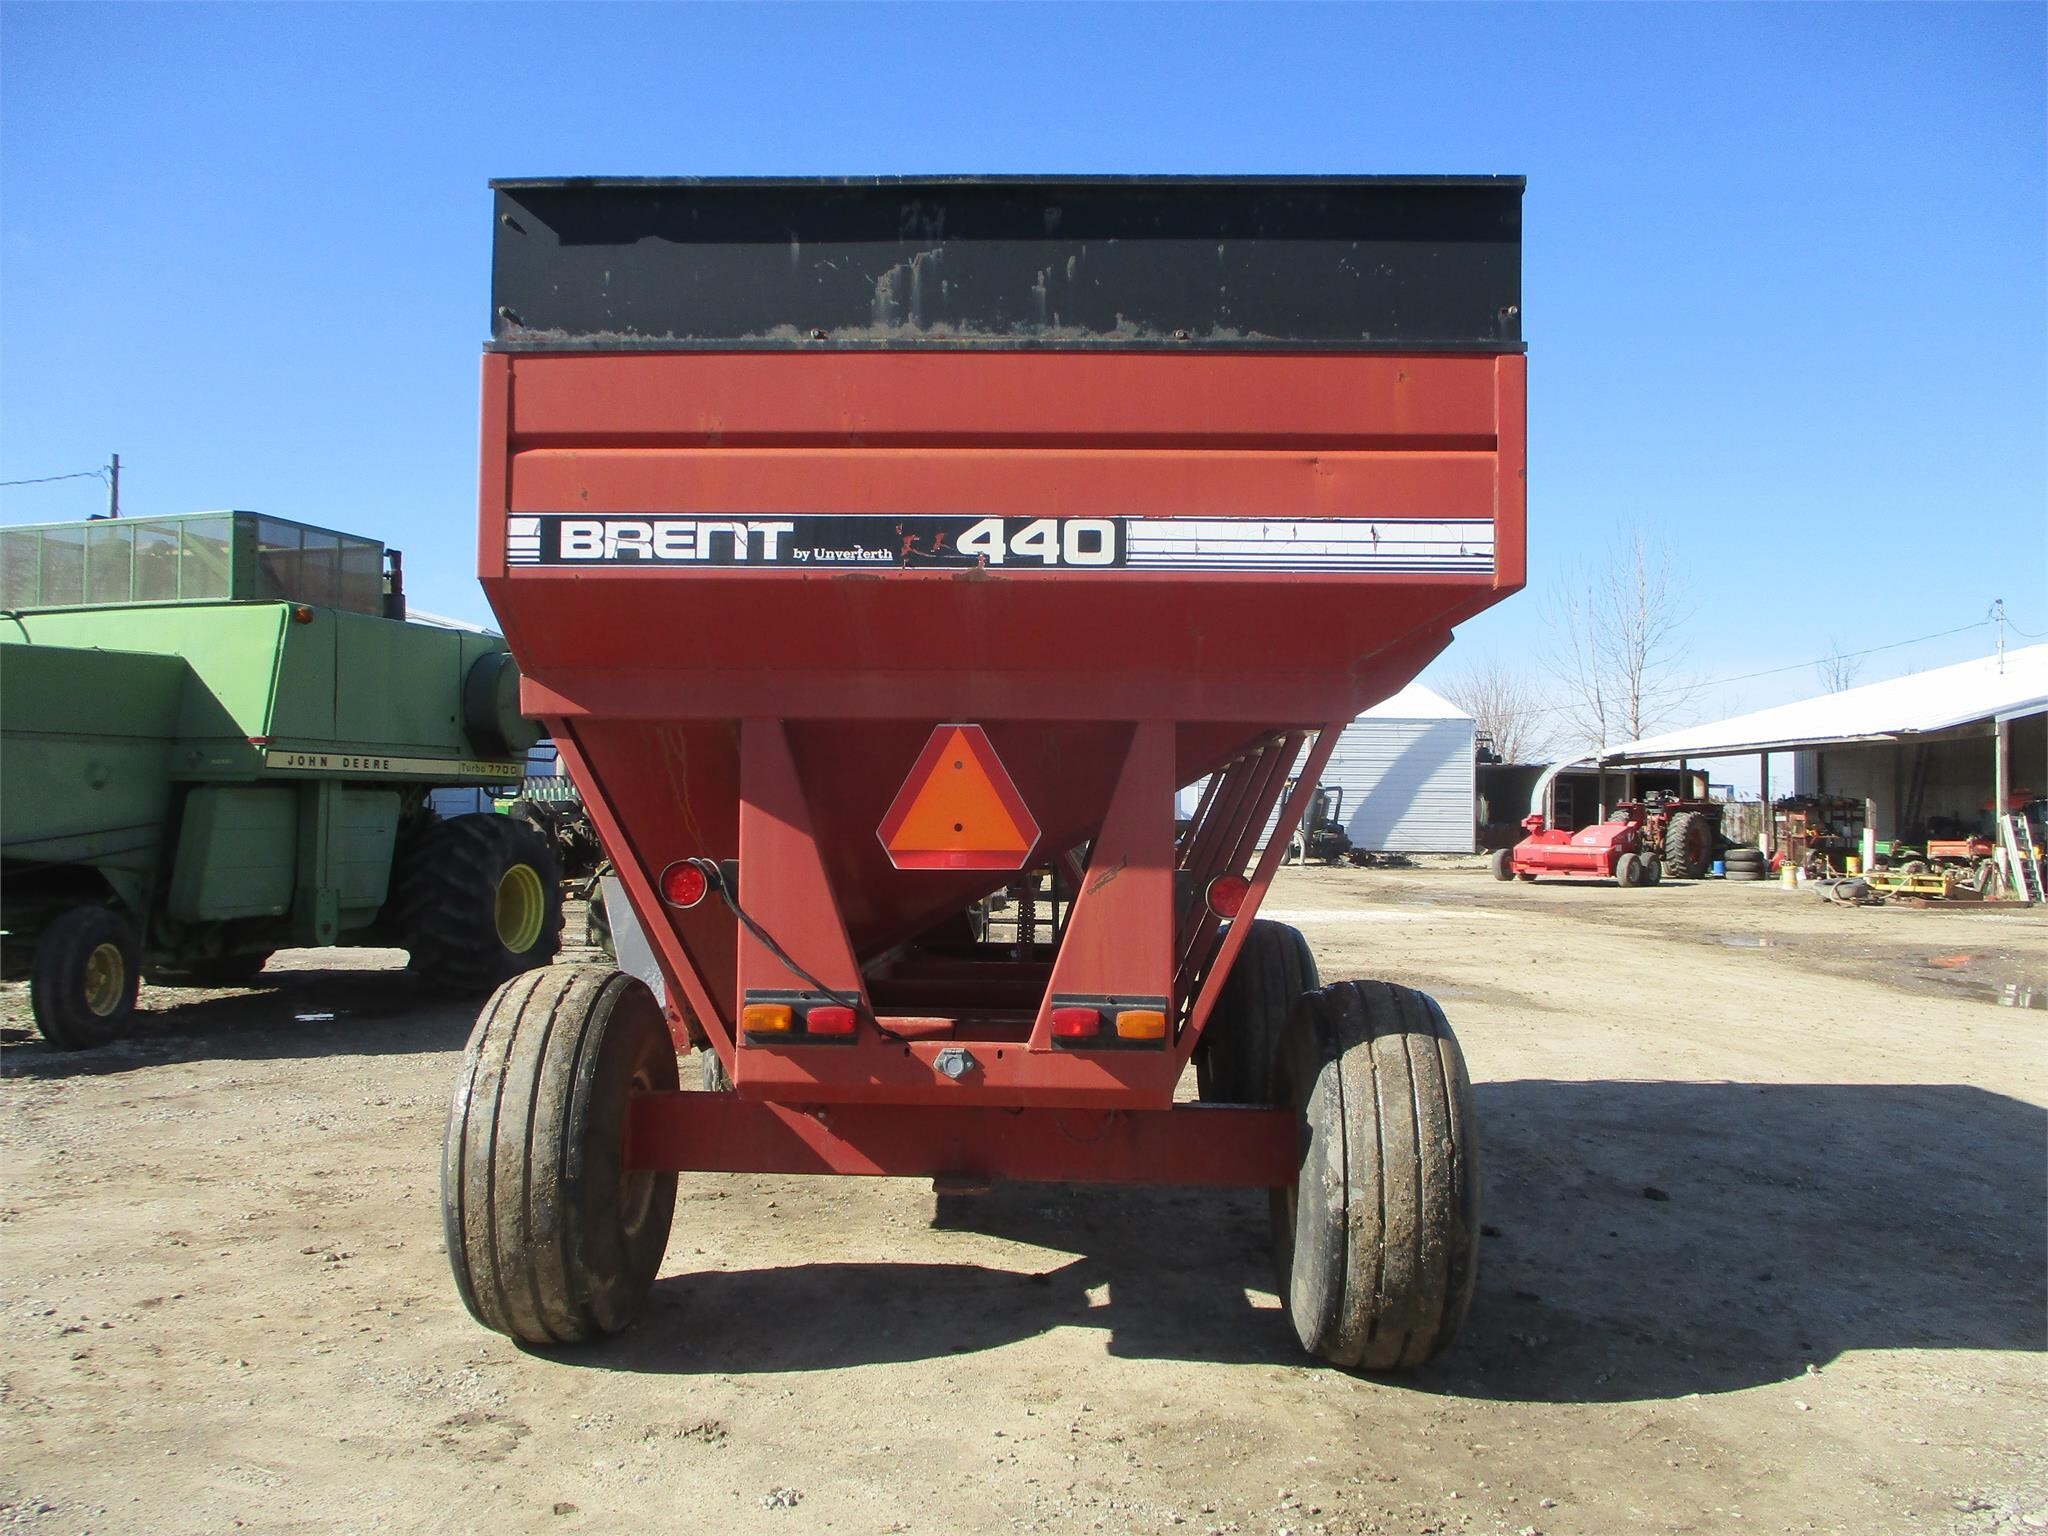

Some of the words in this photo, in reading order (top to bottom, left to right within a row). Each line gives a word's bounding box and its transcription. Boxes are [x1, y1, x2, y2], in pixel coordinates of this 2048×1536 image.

[560, 521, 794, 560] BRENT
[956, 518, 1116, 565] 440
[793, 548, 810, 562] by
[814, 544, 894, 561] Unverferth
[288, 756, 328, 767] JOHN
[343, 757, 390, 770] DEERE
[461, 762, 486, 773] Turbo
[488, 764, 517, 775] 7700
